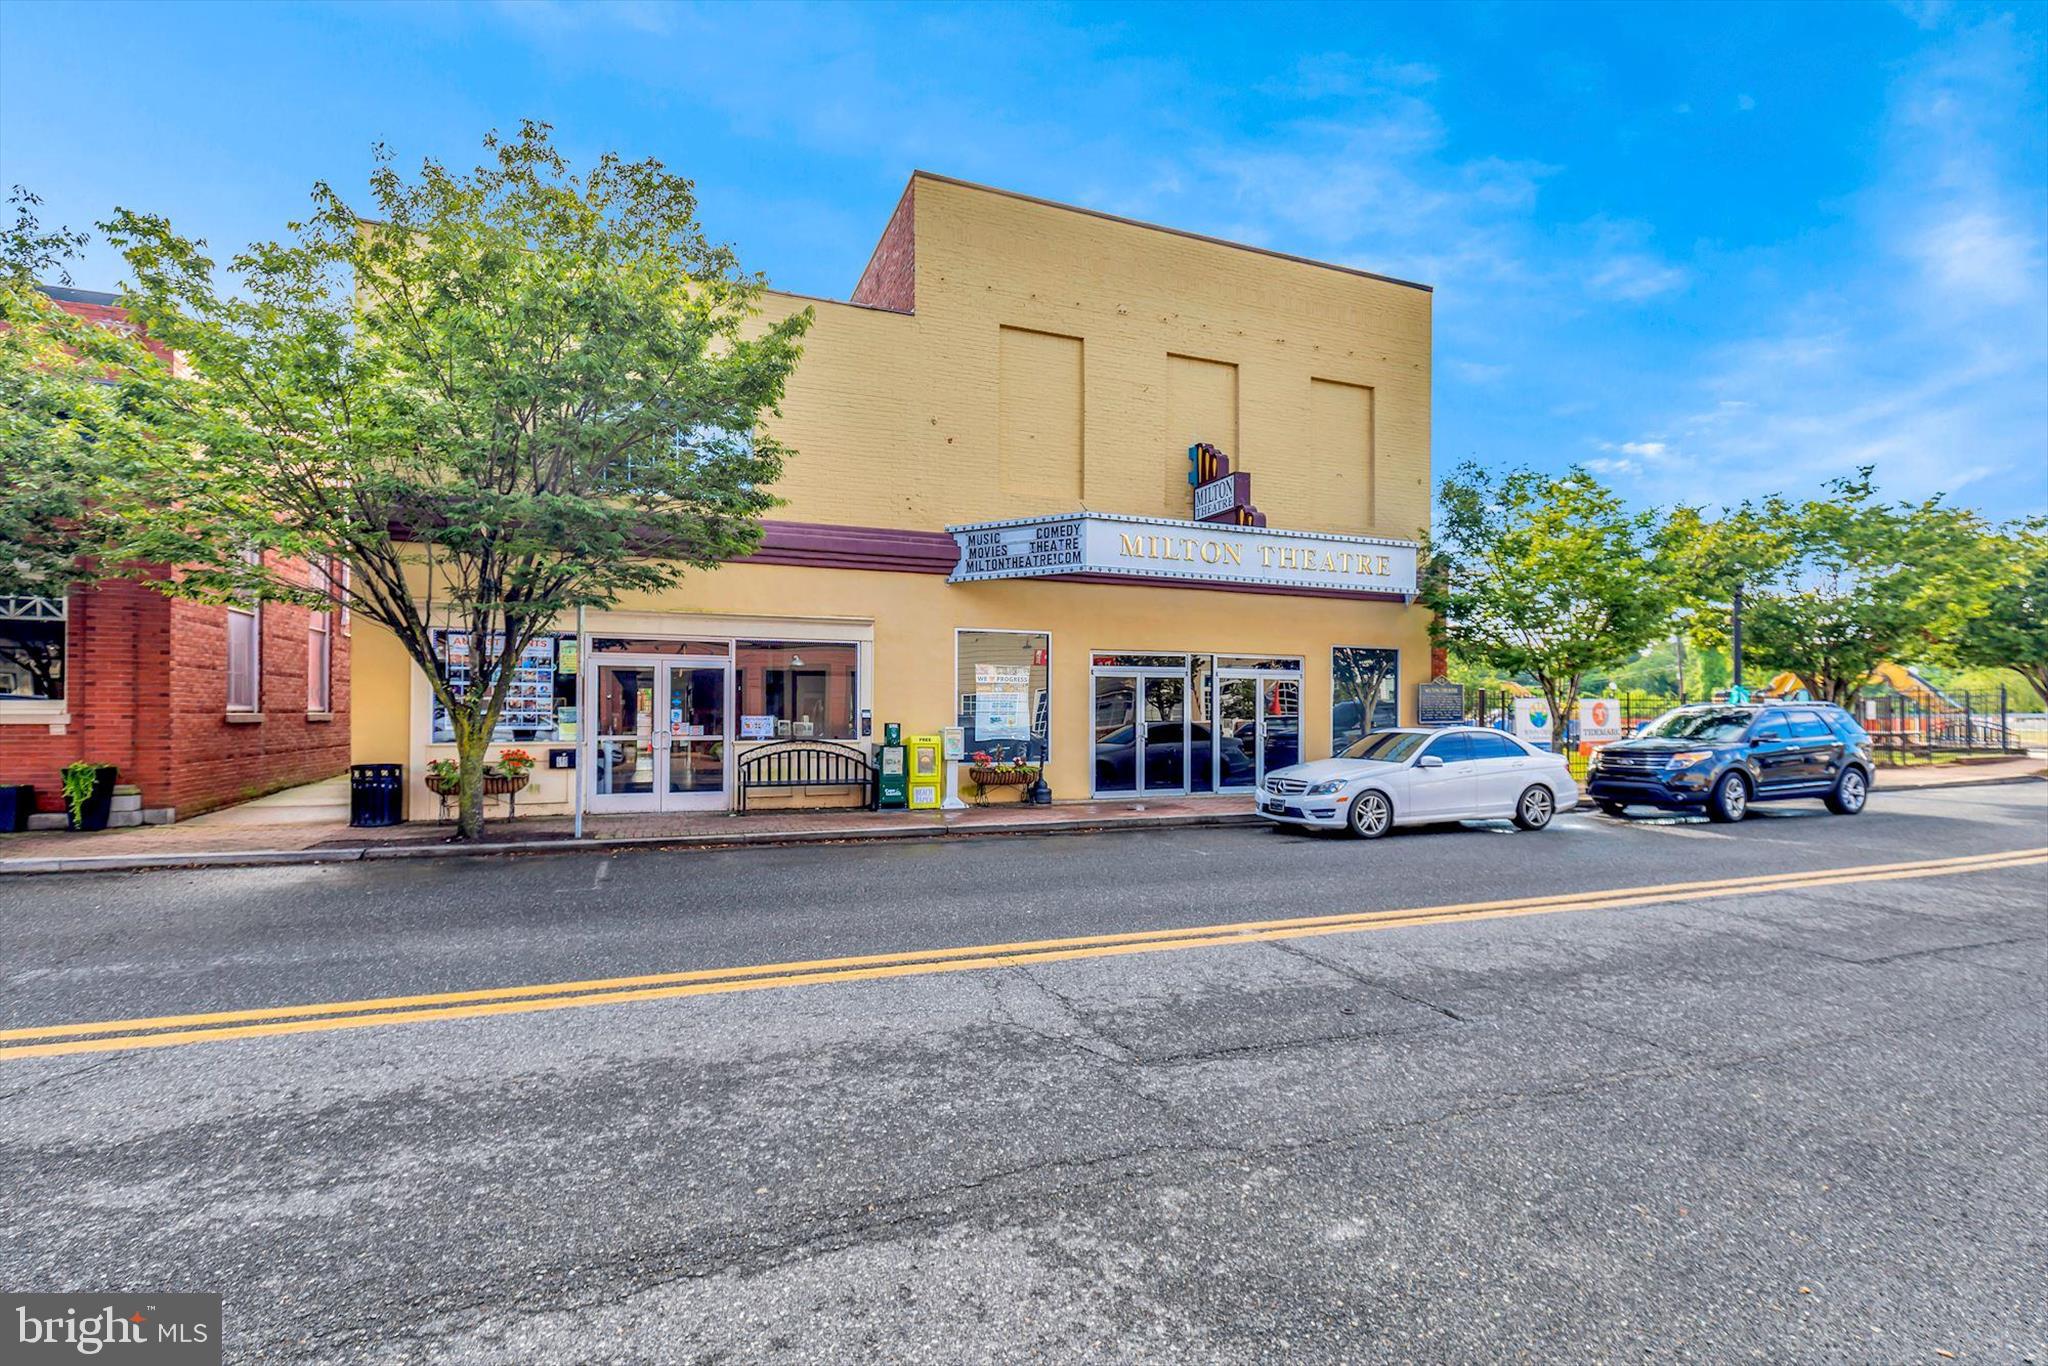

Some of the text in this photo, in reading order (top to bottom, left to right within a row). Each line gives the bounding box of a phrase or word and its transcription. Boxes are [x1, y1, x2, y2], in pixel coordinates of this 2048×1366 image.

[1196, 478, 1233, 507] MILTON
[1197, 496, 1233, 517] THEATRE
[968, 524, 1080, 547] MUSIC COMEDY
[969, 537, 1079, 559] MOVIES THEATRE
[1119, 532, 1392, 577] MILTON THEATRE
